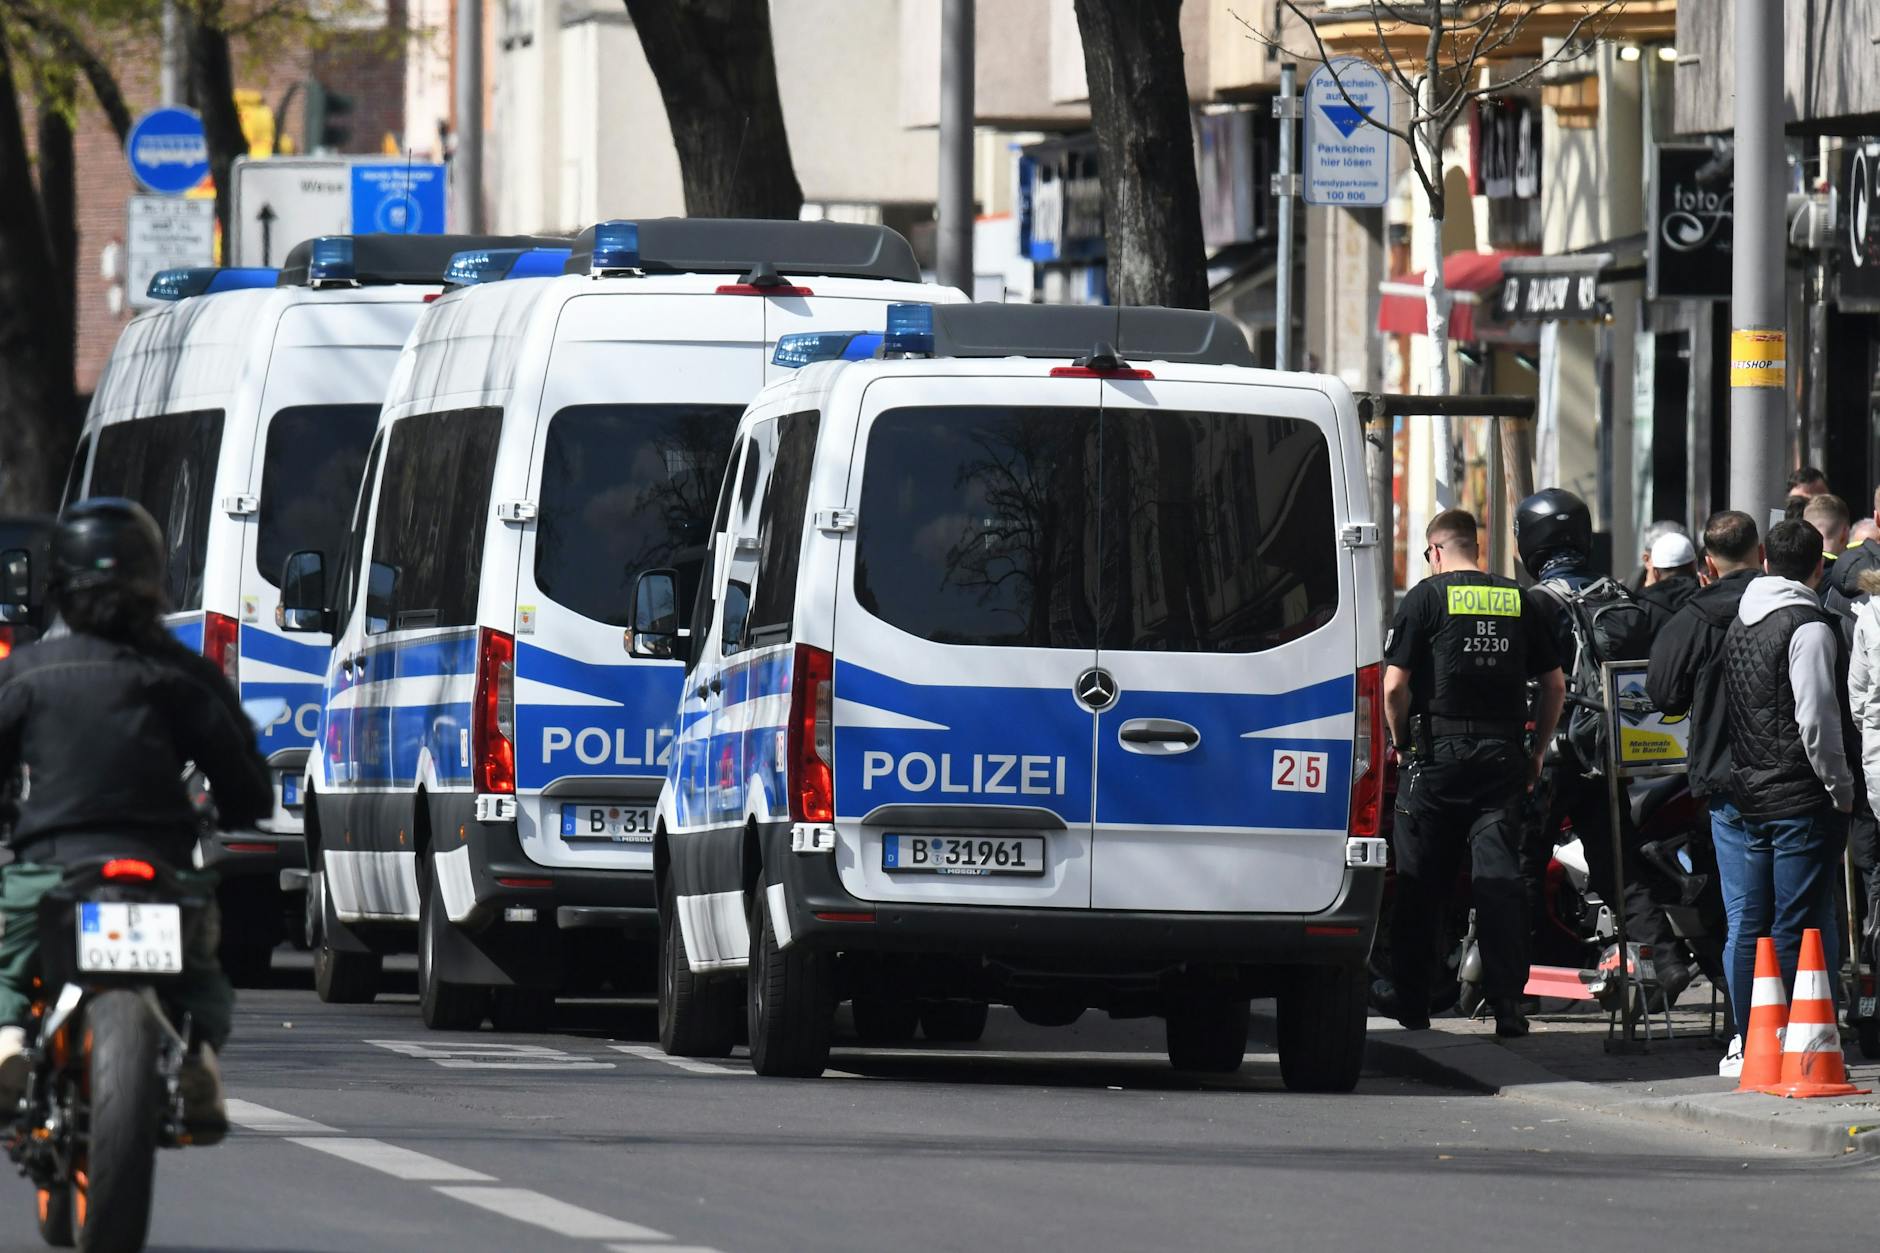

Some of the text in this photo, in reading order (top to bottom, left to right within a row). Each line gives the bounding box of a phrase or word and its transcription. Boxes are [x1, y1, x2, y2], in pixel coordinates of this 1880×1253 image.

[1317, 144, 1376, 153] Parkschein
[1320, 157, 1372, 167] hier lösen
[1312, 180, 1378, 188] Handyparkzone
[1326, 192, 1345, 200] 100
[1452, 590, 1518, 612] POLIZEI
[1476, 621, 1497, 635] BE
[1463, 638, 1509, 652] 25230
[863, 750, 1066, 795] POLIZEI
[1277, 755, 1321, 788] 25
[565, 823, 572, 831] D
[590, 809, 605, 833] B
[887, 839, 1026, 867] D B 31961
